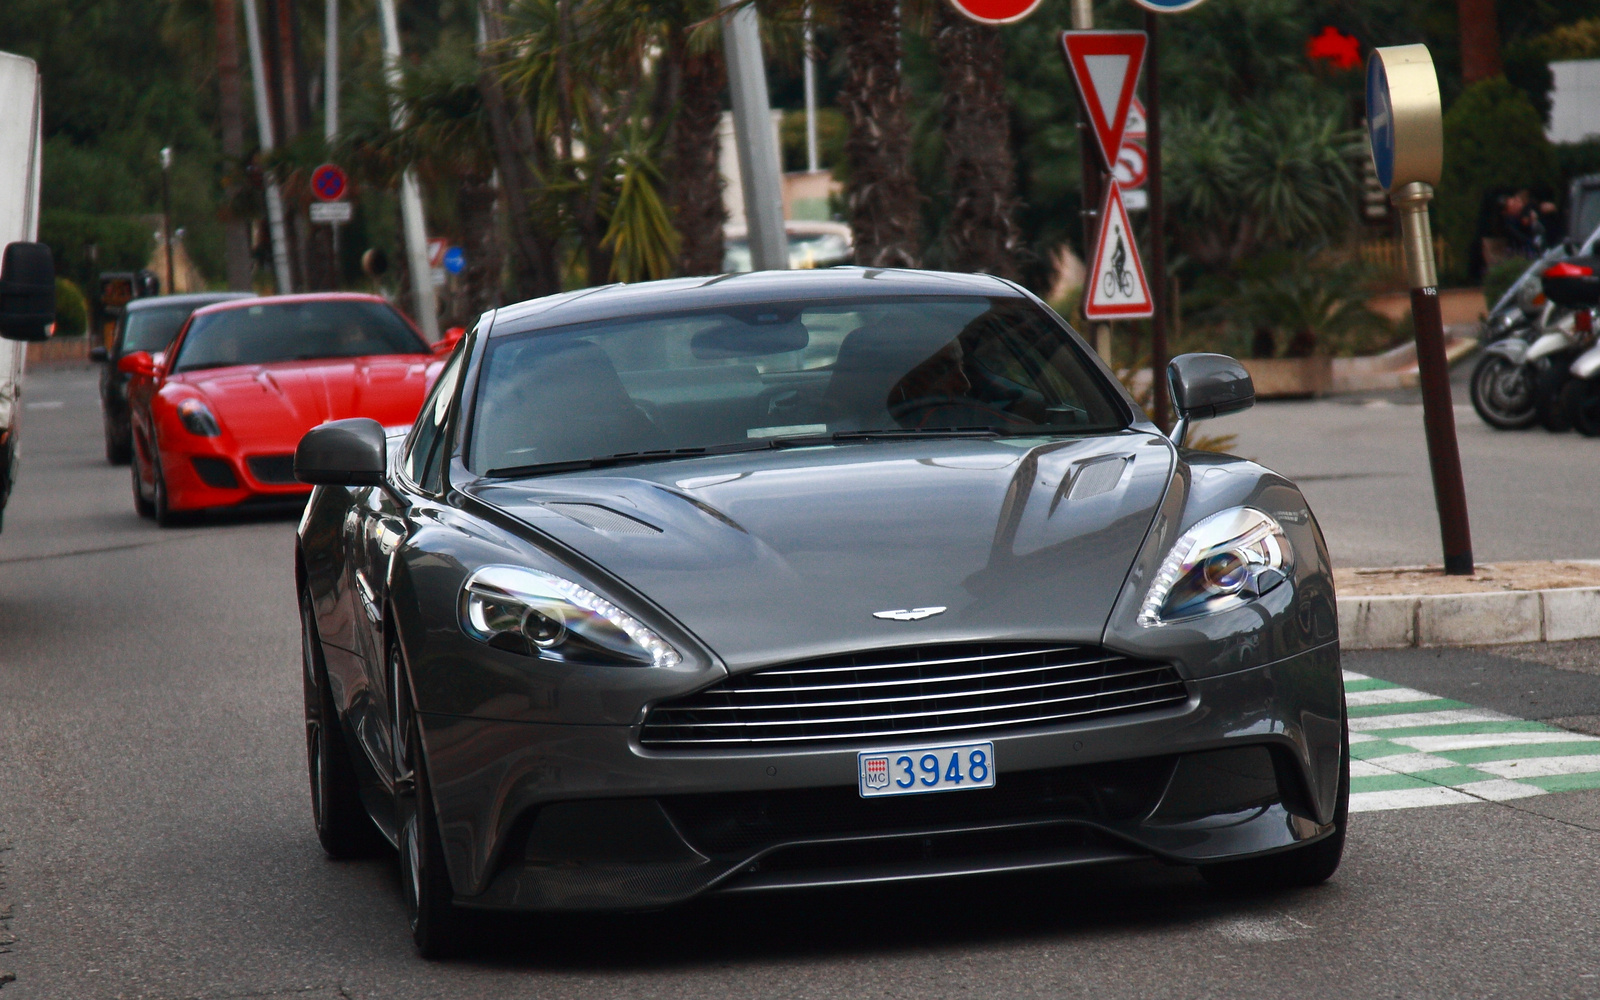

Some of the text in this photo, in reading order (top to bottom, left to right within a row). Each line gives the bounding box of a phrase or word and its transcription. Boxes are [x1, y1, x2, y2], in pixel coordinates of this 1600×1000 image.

[1422, 287, 1437, 295] 195
[868, 749, 988, 788] MC 3948
